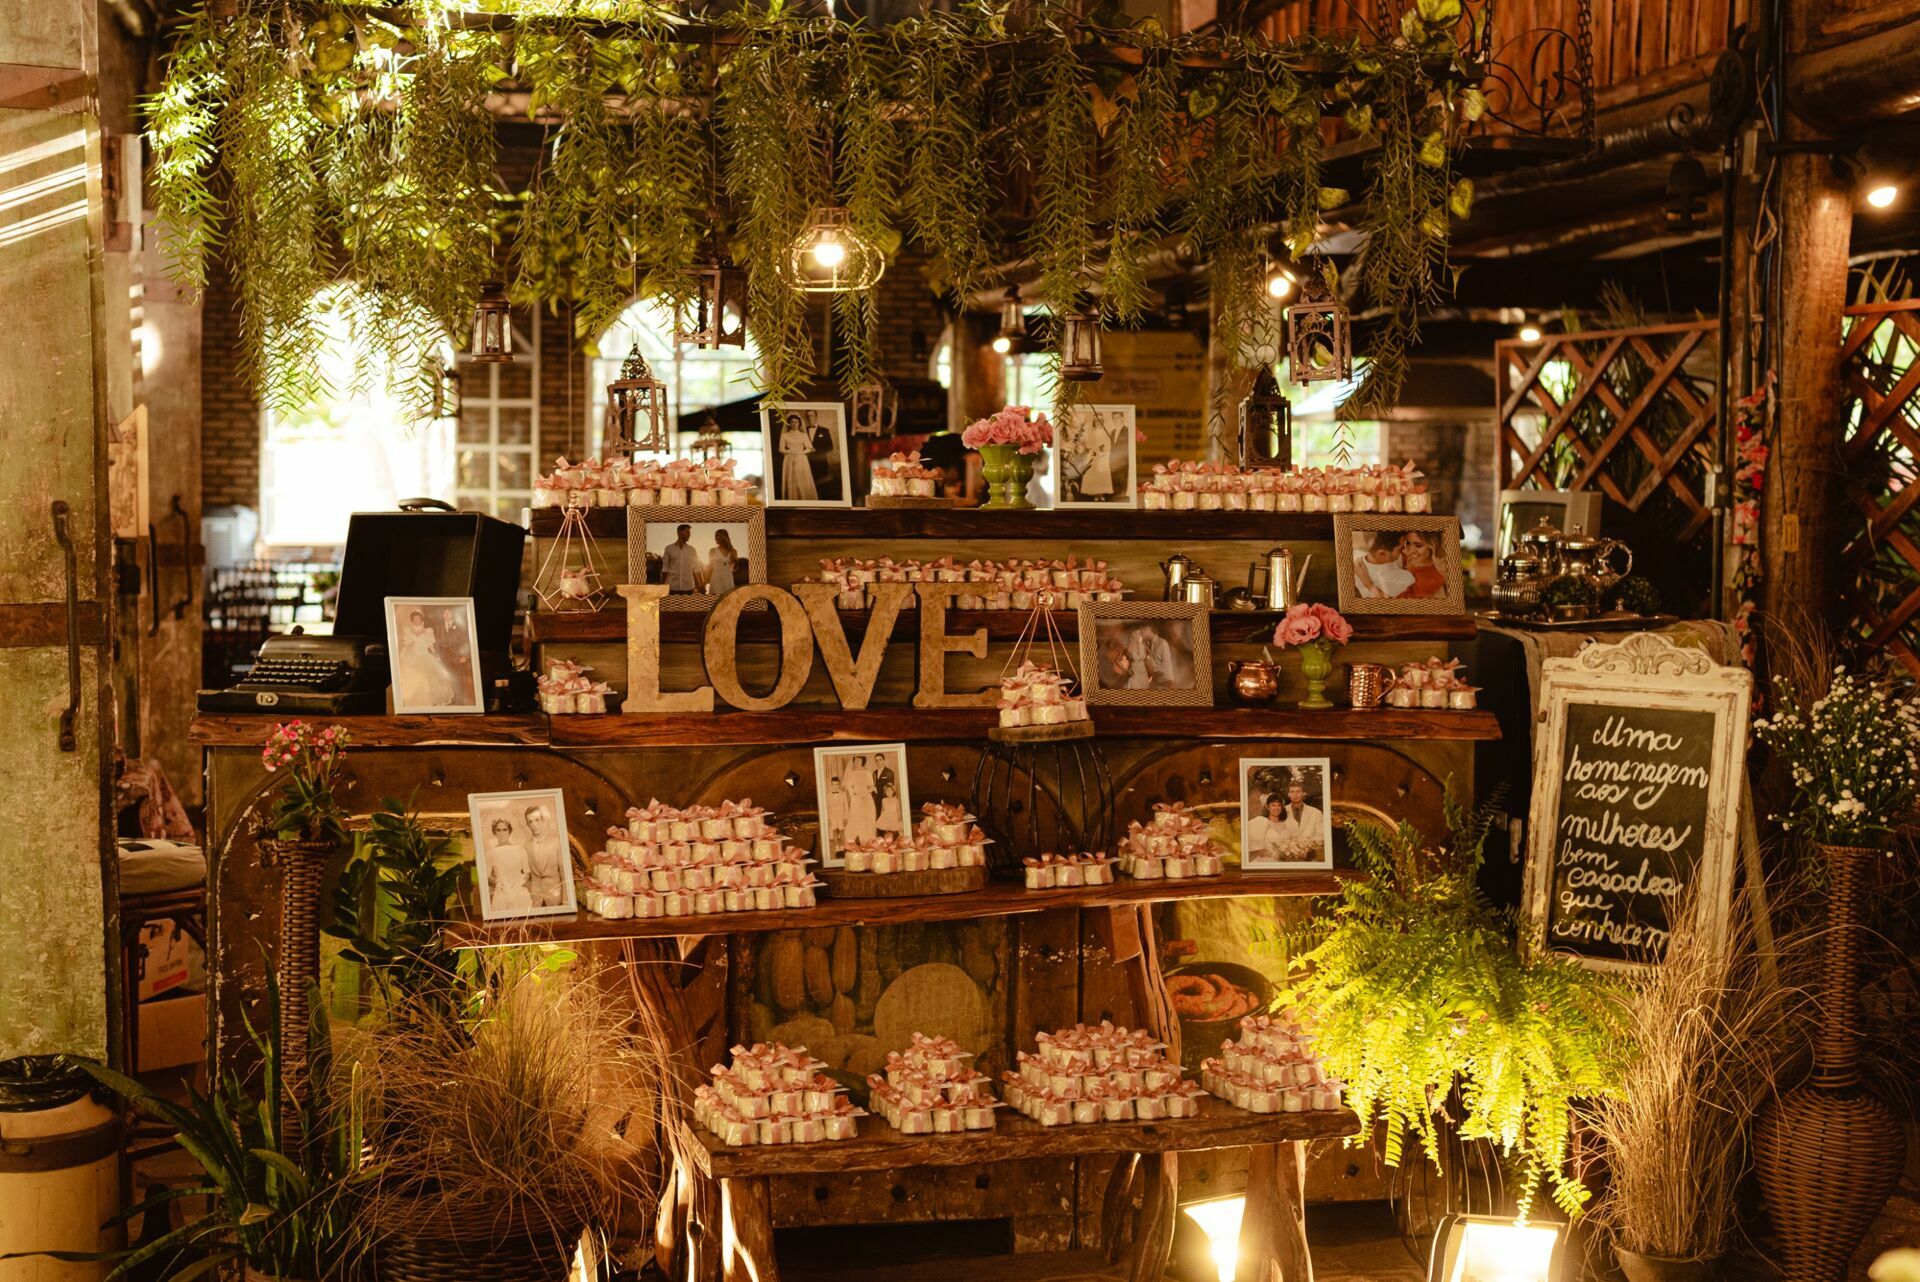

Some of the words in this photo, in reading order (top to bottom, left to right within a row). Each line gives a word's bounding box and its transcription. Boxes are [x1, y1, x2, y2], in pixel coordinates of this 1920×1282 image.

[616, 583, 999, 713] LOVE
[1592, 715, 1683, 752] Uma
[1564, 744, 1709, 810] homenagem
[1575, 782, 1630, 804] aos
[1561, 809, 1692, 852] melhores
[1557, 839, 1619, 871] bem
[1560, 890, 1614, 914] que
